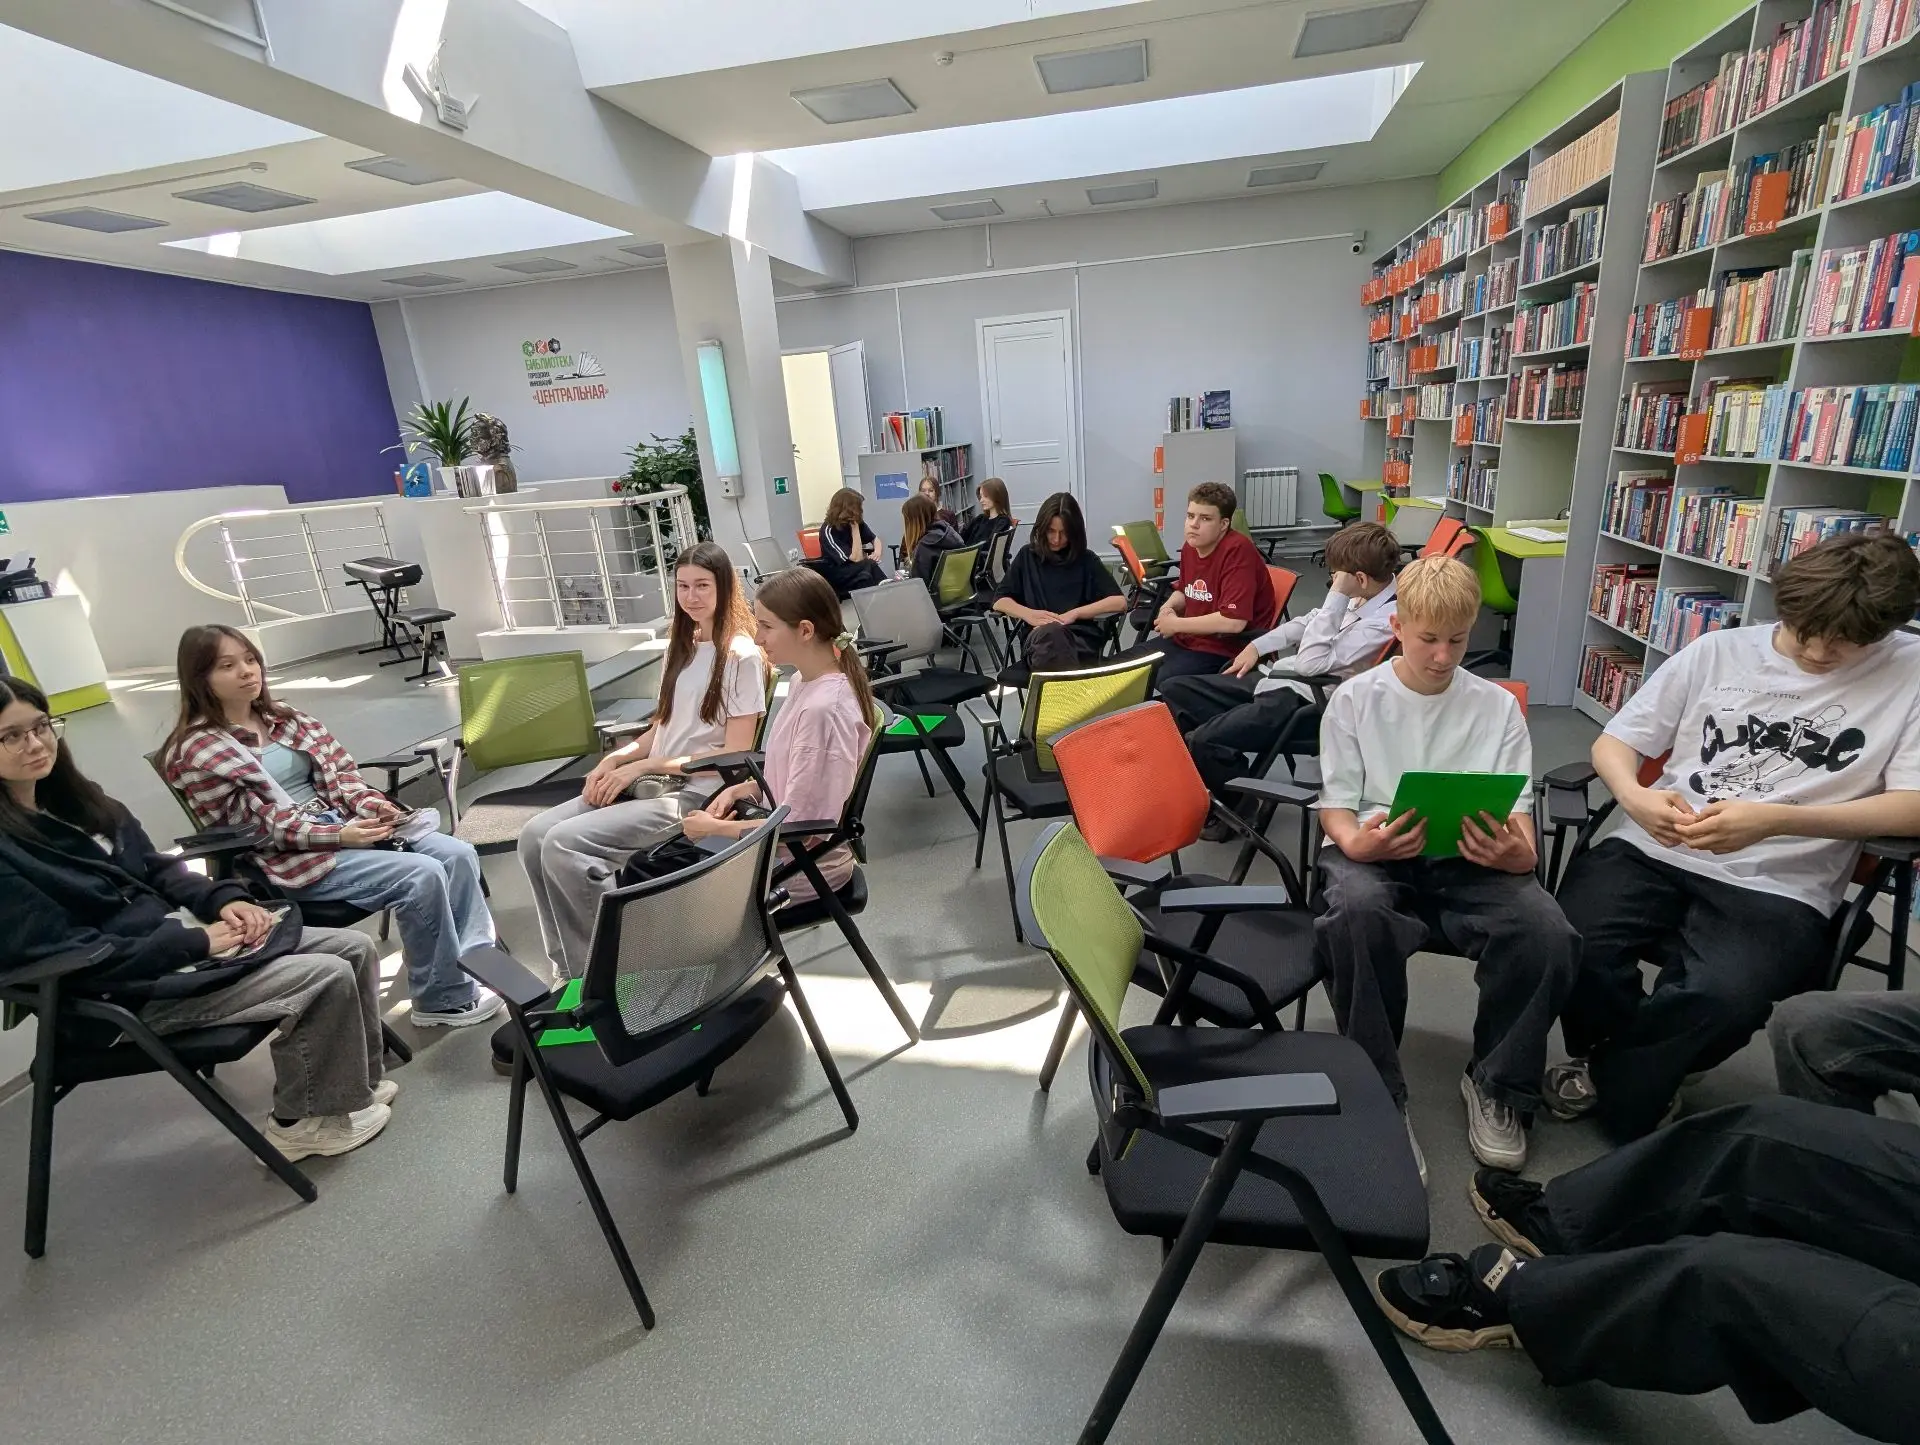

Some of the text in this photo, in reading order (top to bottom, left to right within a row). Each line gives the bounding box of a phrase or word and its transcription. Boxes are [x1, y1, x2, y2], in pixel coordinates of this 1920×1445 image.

[1749, 177, 1764, 221] АРХЕОЛОГИЯ
[1748, 220, 1775, 233] 63.4
[1681, 349, 1702, 359] 63.5
[524, 355, 575, 371] БИБЛИОТЕКА
[528, 371, 550, 379] ГОРОДСКИХ
[529, 379, 553, 388] ИННОВАЦИЙ
[532, 384, 609, 407] «ЦЕНТРАЛЬНАЯ»
[1683, 453, 1698, 462] 65
